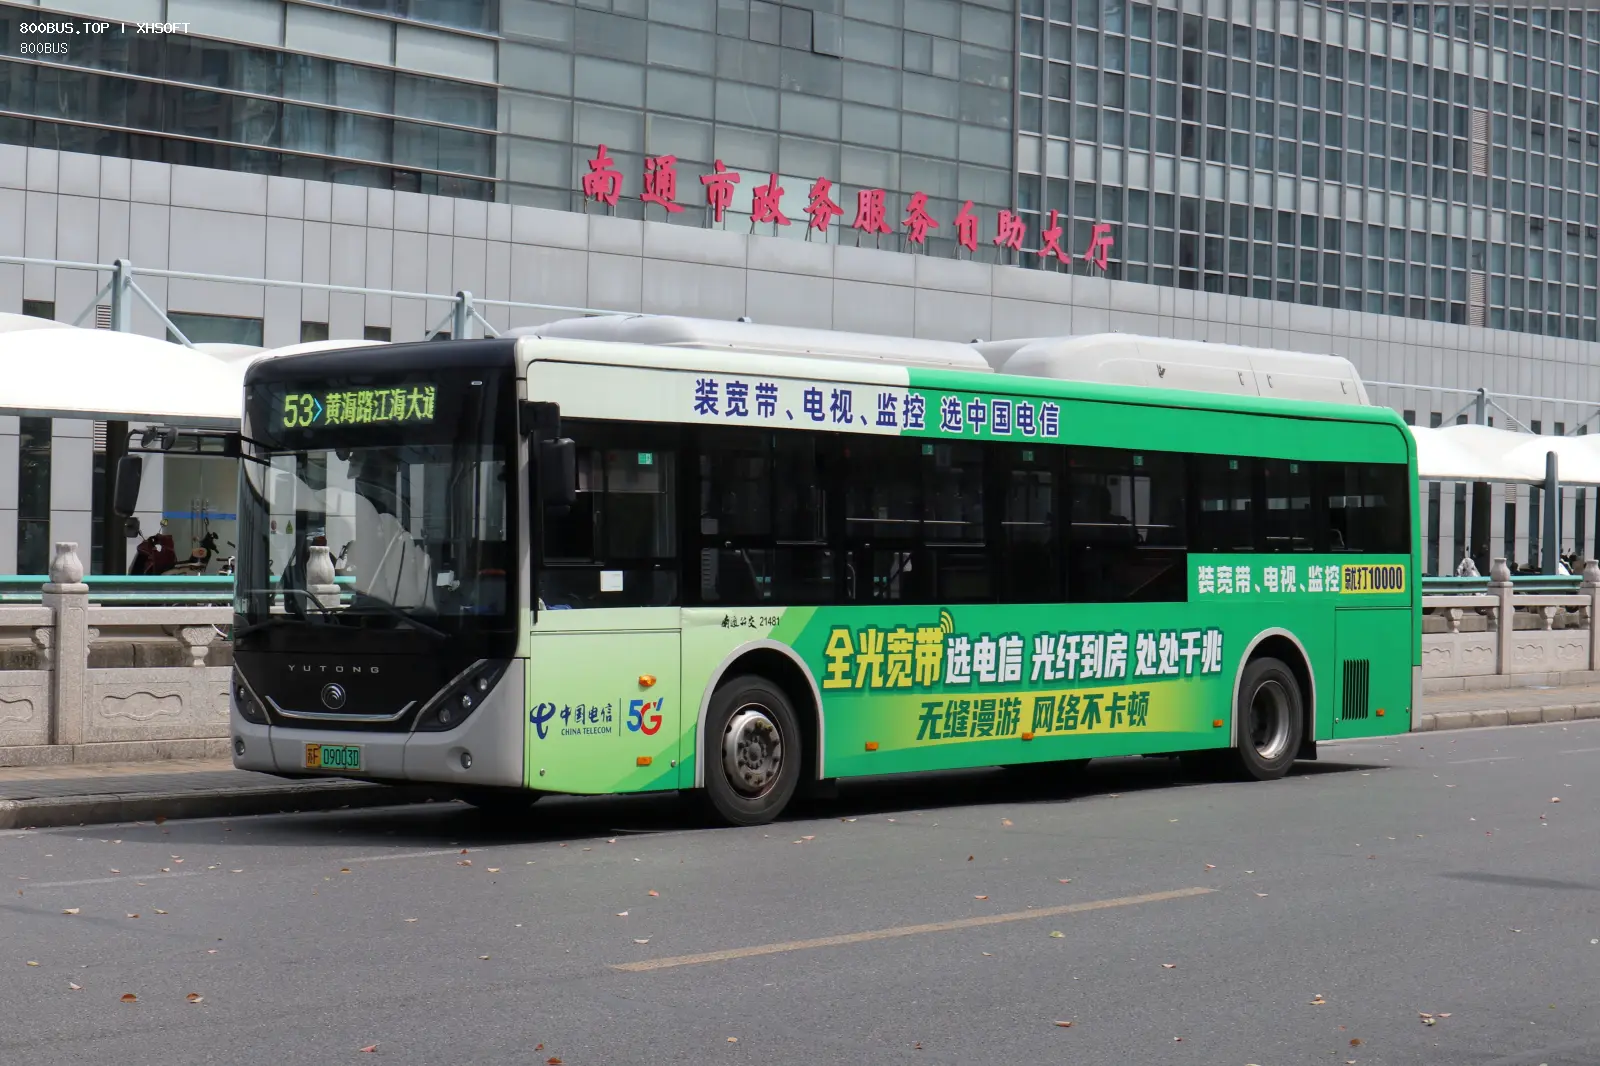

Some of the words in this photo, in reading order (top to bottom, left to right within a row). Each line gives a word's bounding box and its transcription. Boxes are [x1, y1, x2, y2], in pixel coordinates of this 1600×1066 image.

[582, 144, 1115, 271] 南通市政务服务自助大厅
[283, 393, 314, 428] 53
[693, 378, 925, 430] 装宽带、电视、监控
[939, 395, 1060, 437] 选中国电信
[1198, 565, 1340, 594] 装宽带、电视、监控
[1344, 566, 1404, 591] 就打10000
[759, 616, 780, 627] 21481
[288, 664, 380, 674] YUTONG
[1030, 632, 1129, 681] 光纤到房
[1132, 627, 1223, 681] 处处千兆
[560, 703, 612, 727] 中国电信
[561, 728, 581, 736] CHINA
[583, 726, 612, 735] TELECOM
[626, 697, 664, 736] 5G
[917, 700, 1021, 741] 无缝漫游
[1031, 691, 1150, 733] 网络不卡顿
